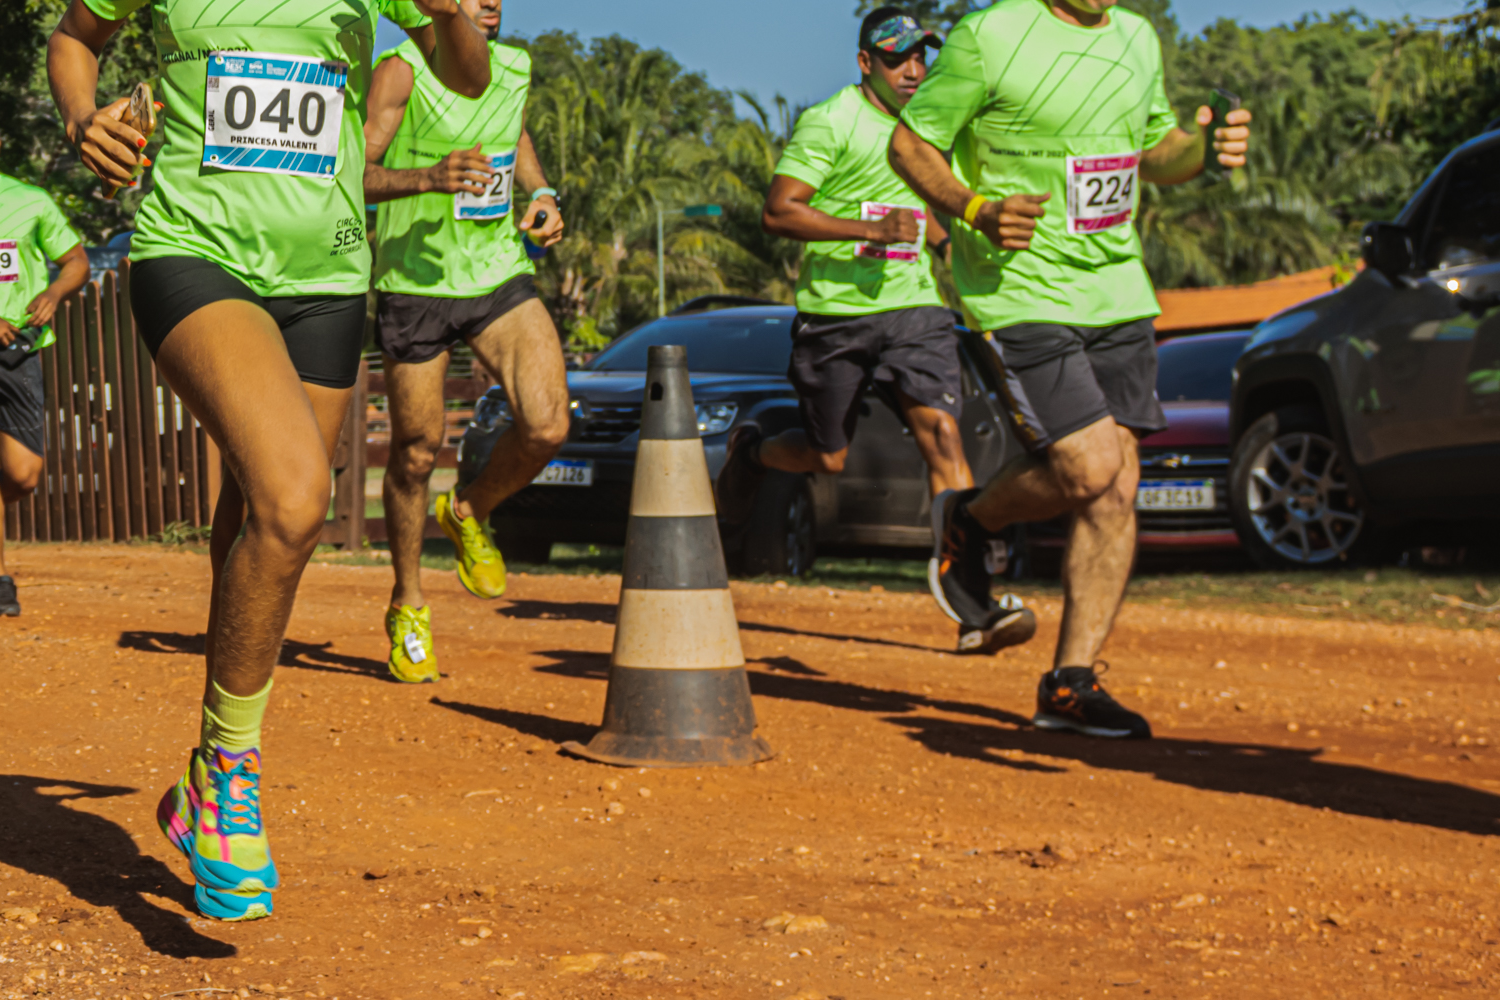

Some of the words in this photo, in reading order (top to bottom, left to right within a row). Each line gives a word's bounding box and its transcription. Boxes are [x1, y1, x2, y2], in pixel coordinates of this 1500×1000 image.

[224, 85, 326, 137] 040
[230, 135, 278, 147] PRINCESA
[280, 140, 318, 150] VALENTE
[1085, 173, 1134, 207] 224
[333, 227, 364, 248] SESC
